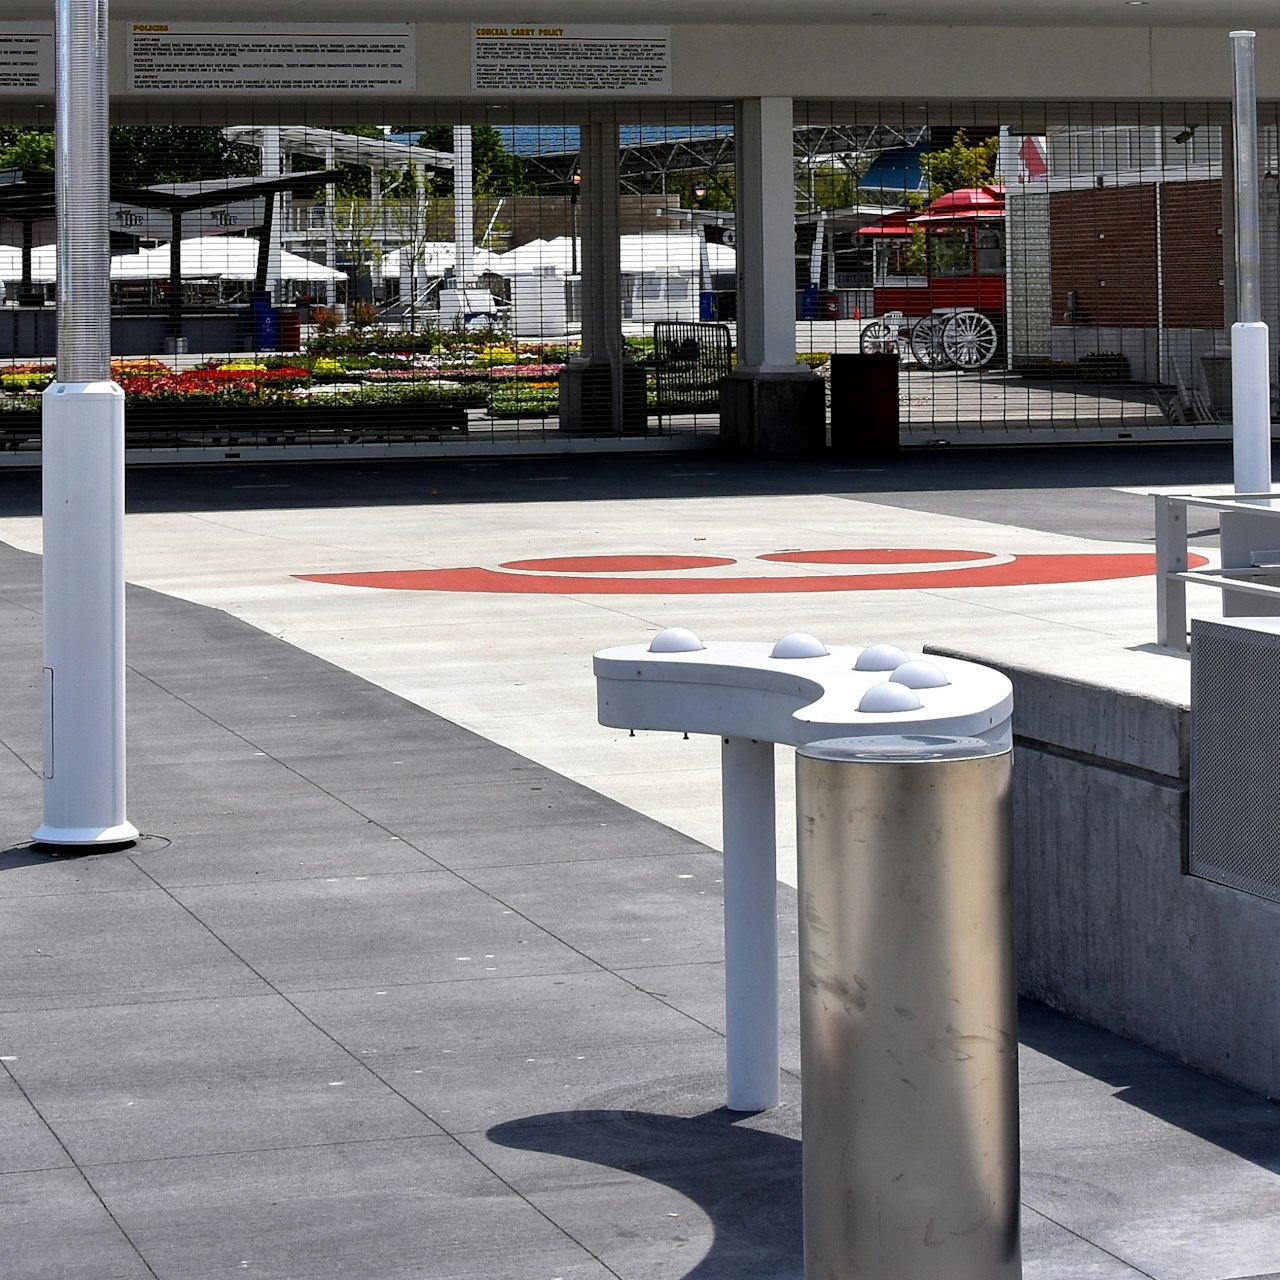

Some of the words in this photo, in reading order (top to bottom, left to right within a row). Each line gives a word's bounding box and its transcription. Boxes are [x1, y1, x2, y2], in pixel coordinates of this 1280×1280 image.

[476, 28, 508, 36] CONCEAL
[511, 28, 535, 36] CARRY
[538, 28, 564, 36] POLICY
